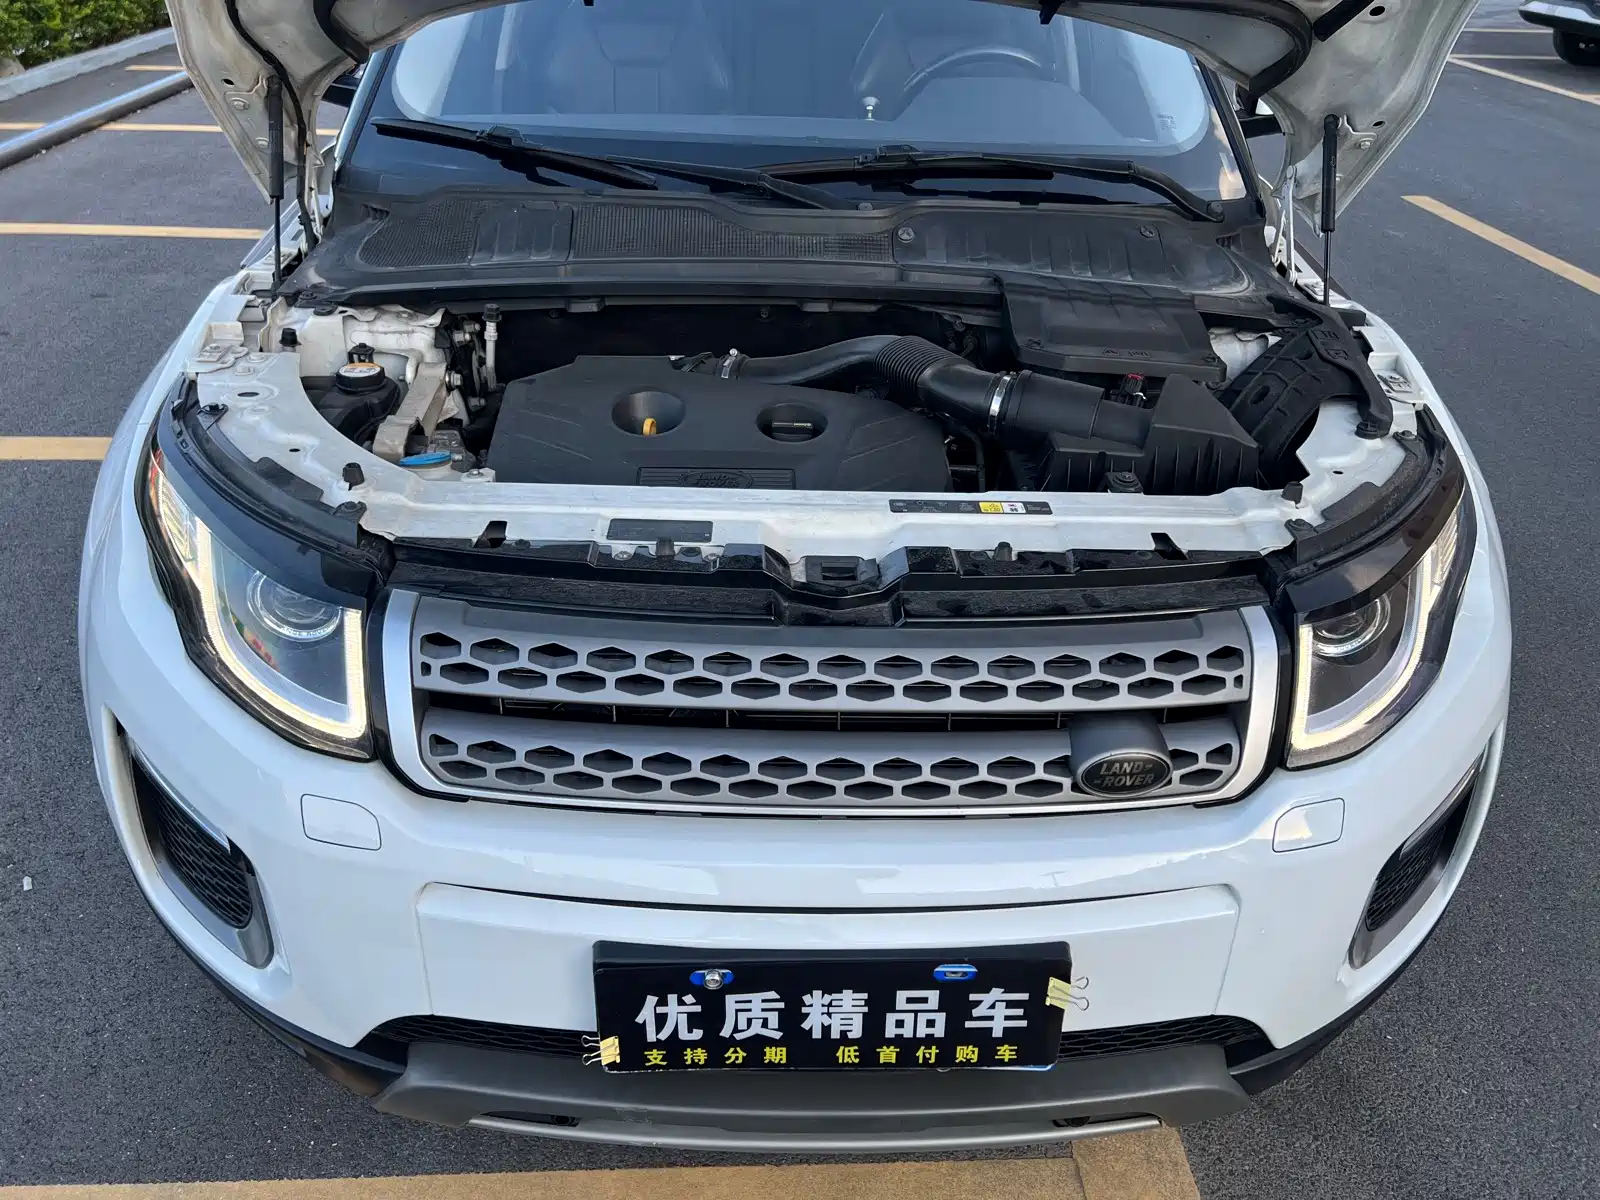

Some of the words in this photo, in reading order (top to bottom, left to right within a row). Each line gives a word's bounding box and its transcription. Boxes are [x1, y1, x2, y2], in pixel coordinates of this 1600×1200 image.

[635, 988, 1030, 1042] 优质精品车
[644, 1046, 787, 1066] 支持分期
[836, 1044, 1018, 1064] 低首付购车
